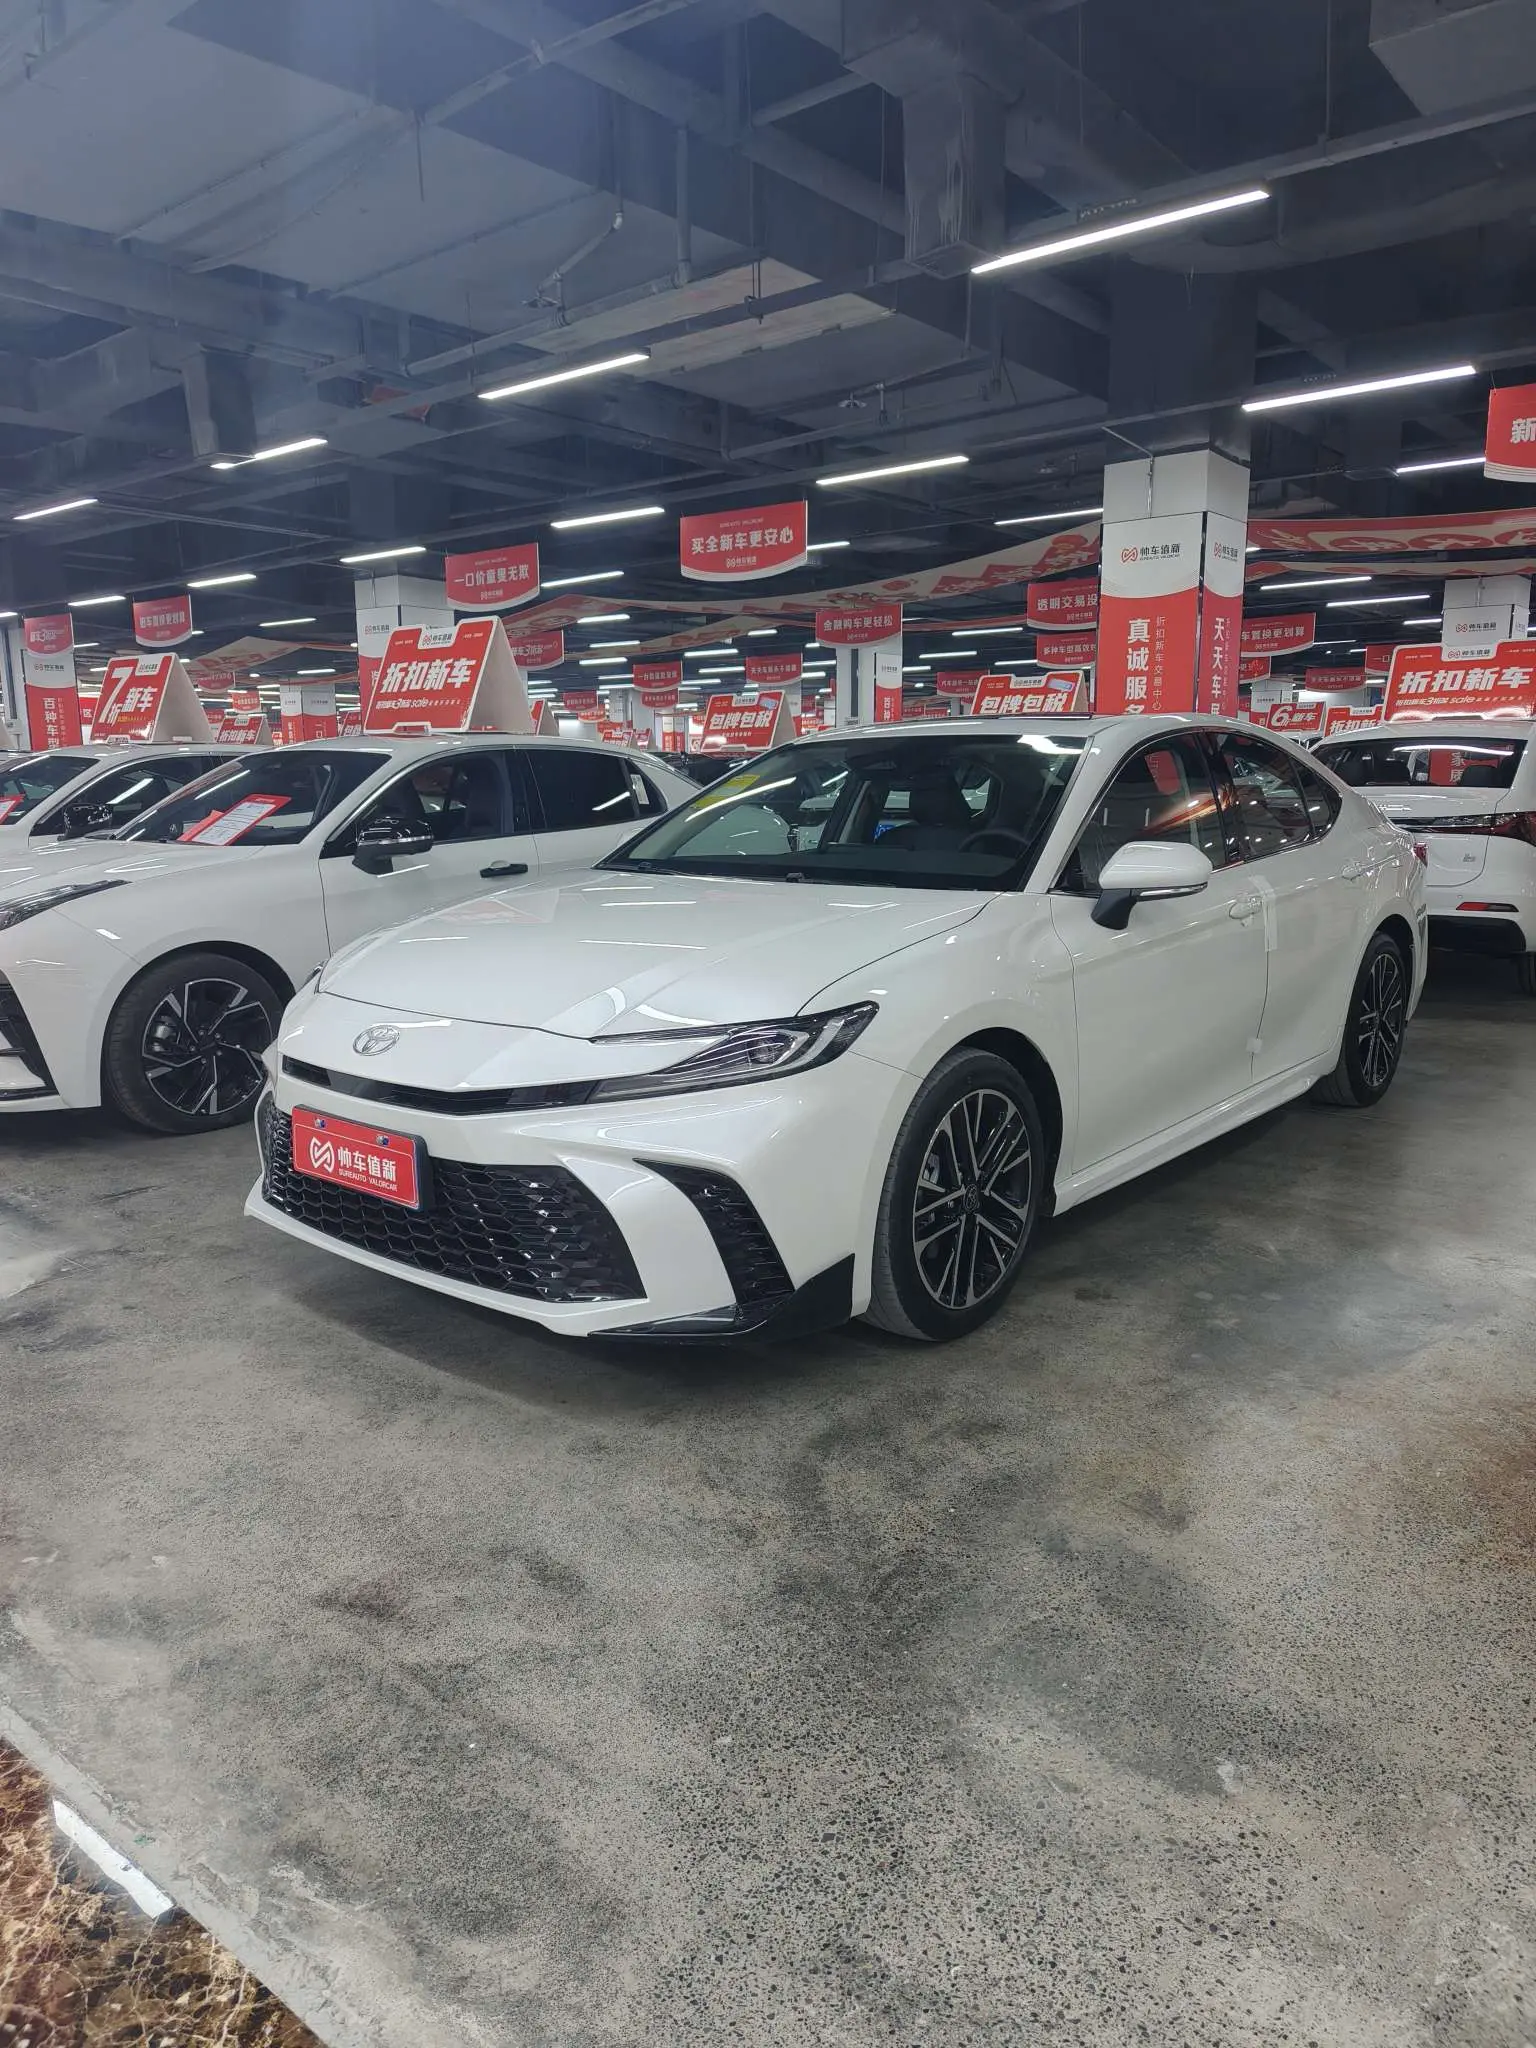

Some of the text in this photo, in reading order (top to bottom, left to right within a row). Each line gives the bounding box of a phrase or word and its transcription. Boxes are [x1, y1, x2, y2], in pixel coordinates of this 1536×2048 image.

[690, 526, 794, 555] 买全新车更安心
[1140, 544, 1180, 556] 帅车值新
[453, 564, 529, 587] 一口价童叟无欺
[823, 615, 893, 631] 金融购车更轻松
[380, 658, 476, 693] 折扣新车
[1152, 616, 1165, 711] 折扣新车交易中心
[1398, 667, 1533, 694] 折扣新车
[980, 693, 1067, 714] 包牌包税
[43, 697, 59, 750] 百种车型
[709, 711, 772, 729] 包牌包税
[337, 1146, 396, 1182] 帅车值新
